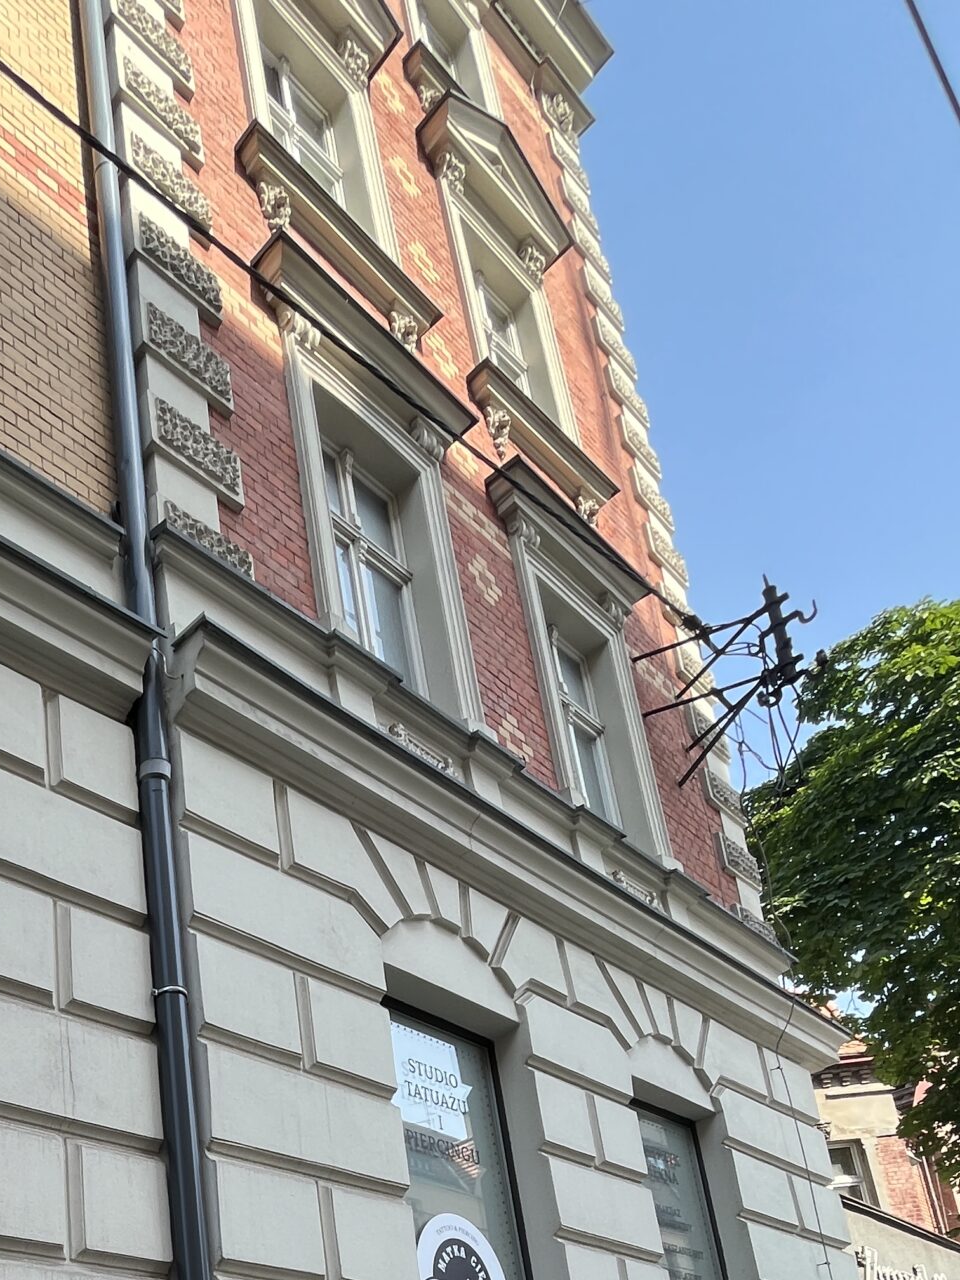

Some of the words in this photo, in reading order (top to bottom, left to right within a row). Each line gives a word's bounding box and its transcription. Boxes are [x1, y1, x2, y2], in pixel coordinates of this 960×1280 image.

[407, 1058, 458, 1089] STUDIO
[404, 1080, 468, 1115] TATUAŻU
[438, 1115, 444, 1131] I
[405, 1128, 480, 1165] PIERCINGU
[437, 1245, 466, 1273] MATKA
